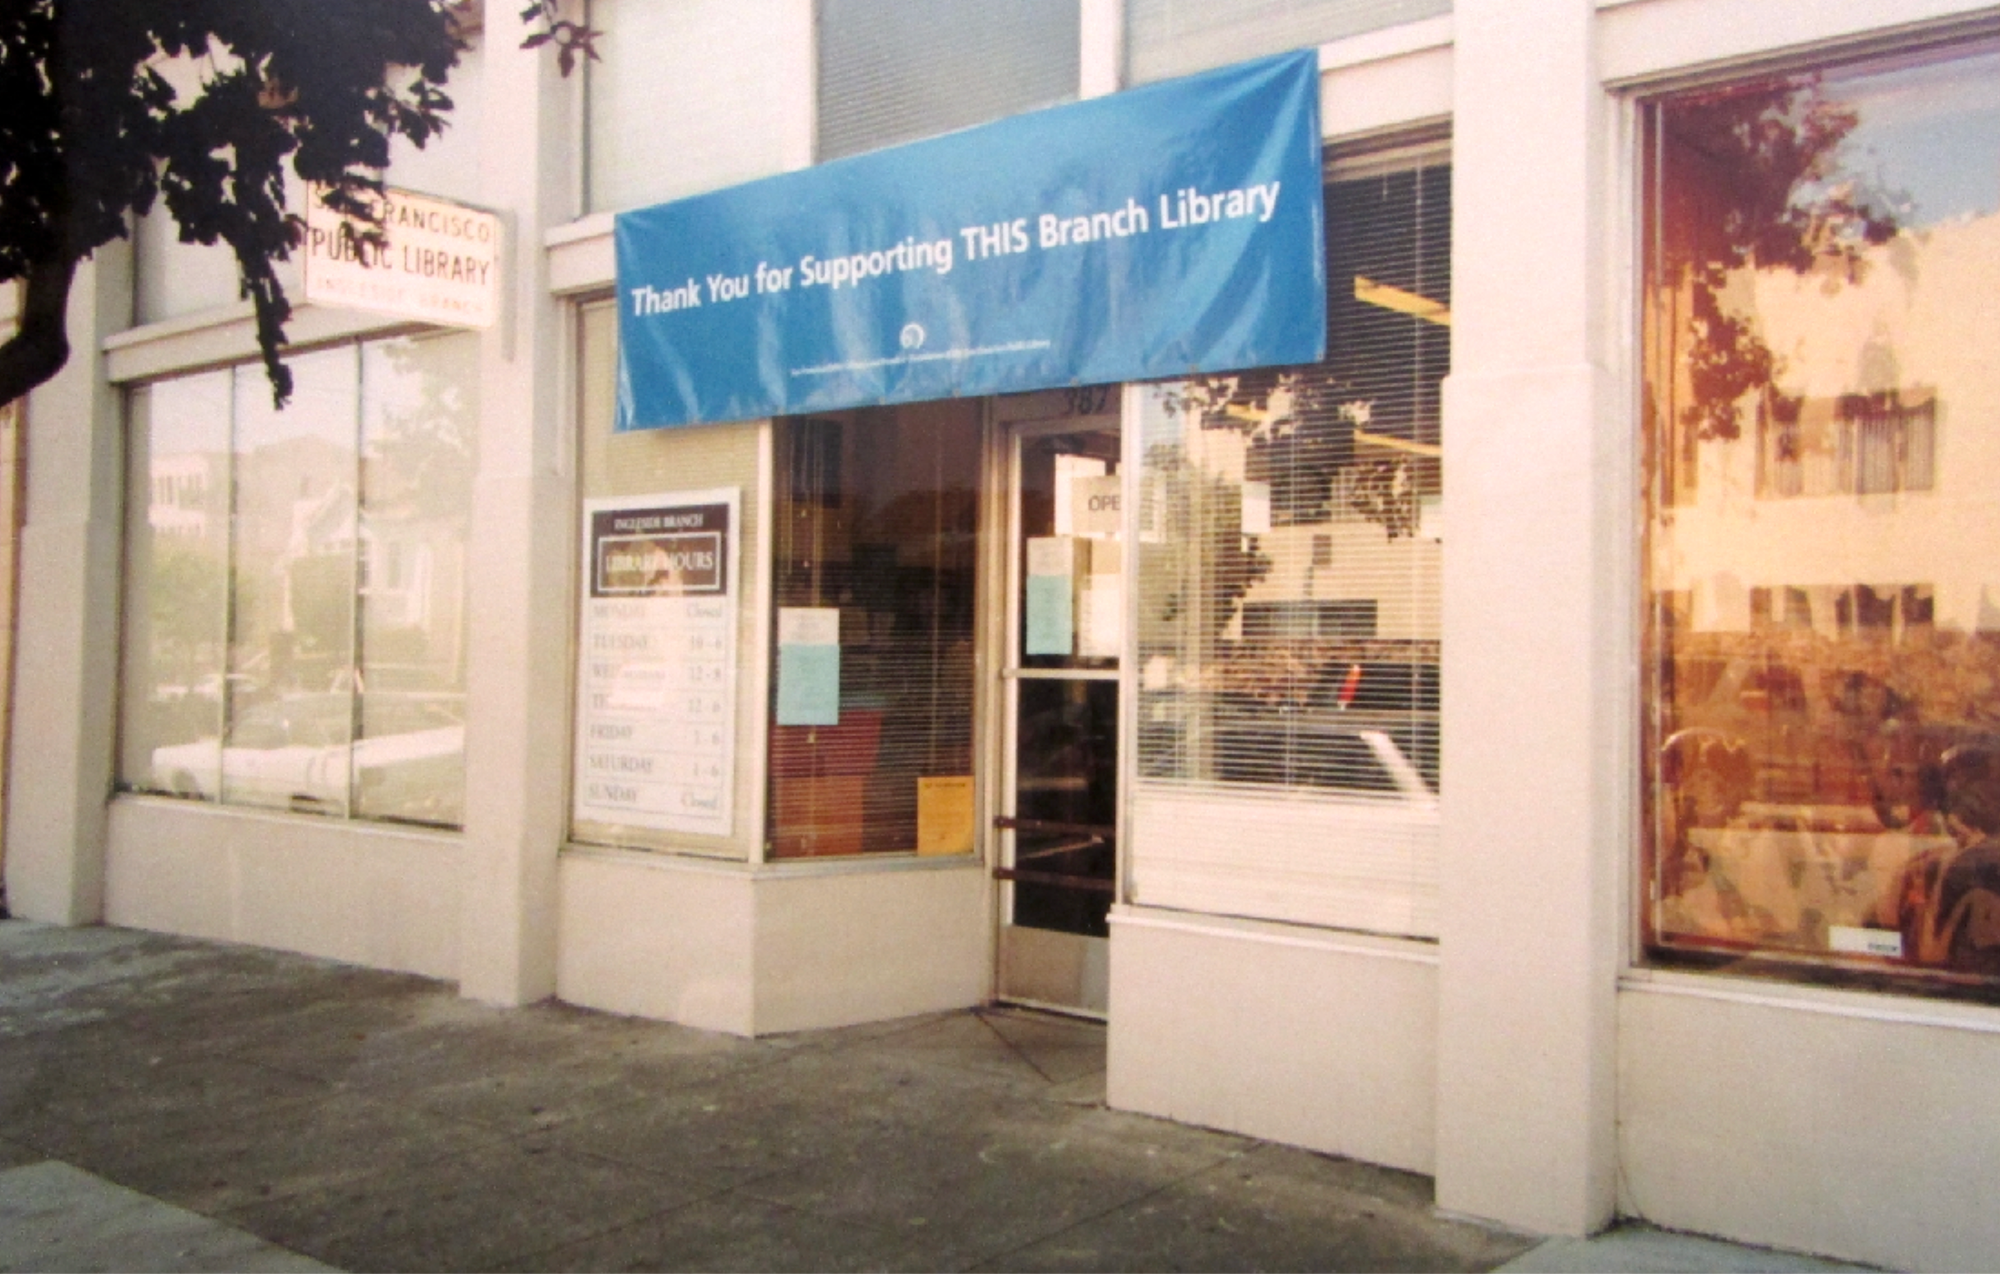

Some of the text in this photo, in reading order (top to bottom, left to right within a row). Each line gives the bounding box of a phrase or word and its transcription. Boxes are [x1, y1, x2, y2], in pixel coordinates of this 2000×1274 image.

[311, 227, 490, 286] PUBIC LIBRARY
[631, 181, 1281, 316] Thank You for Supporting THIS Branch Library
[1087, 494, 1121, 511] OPE
[613, 513, 704, 531] INGLESIDE BRANCH
[589, 723, 634, 741] FRIDAY
[589, 753, 655, 775] SATURDAY
[588, 783, 638, 803] SUNDAY
